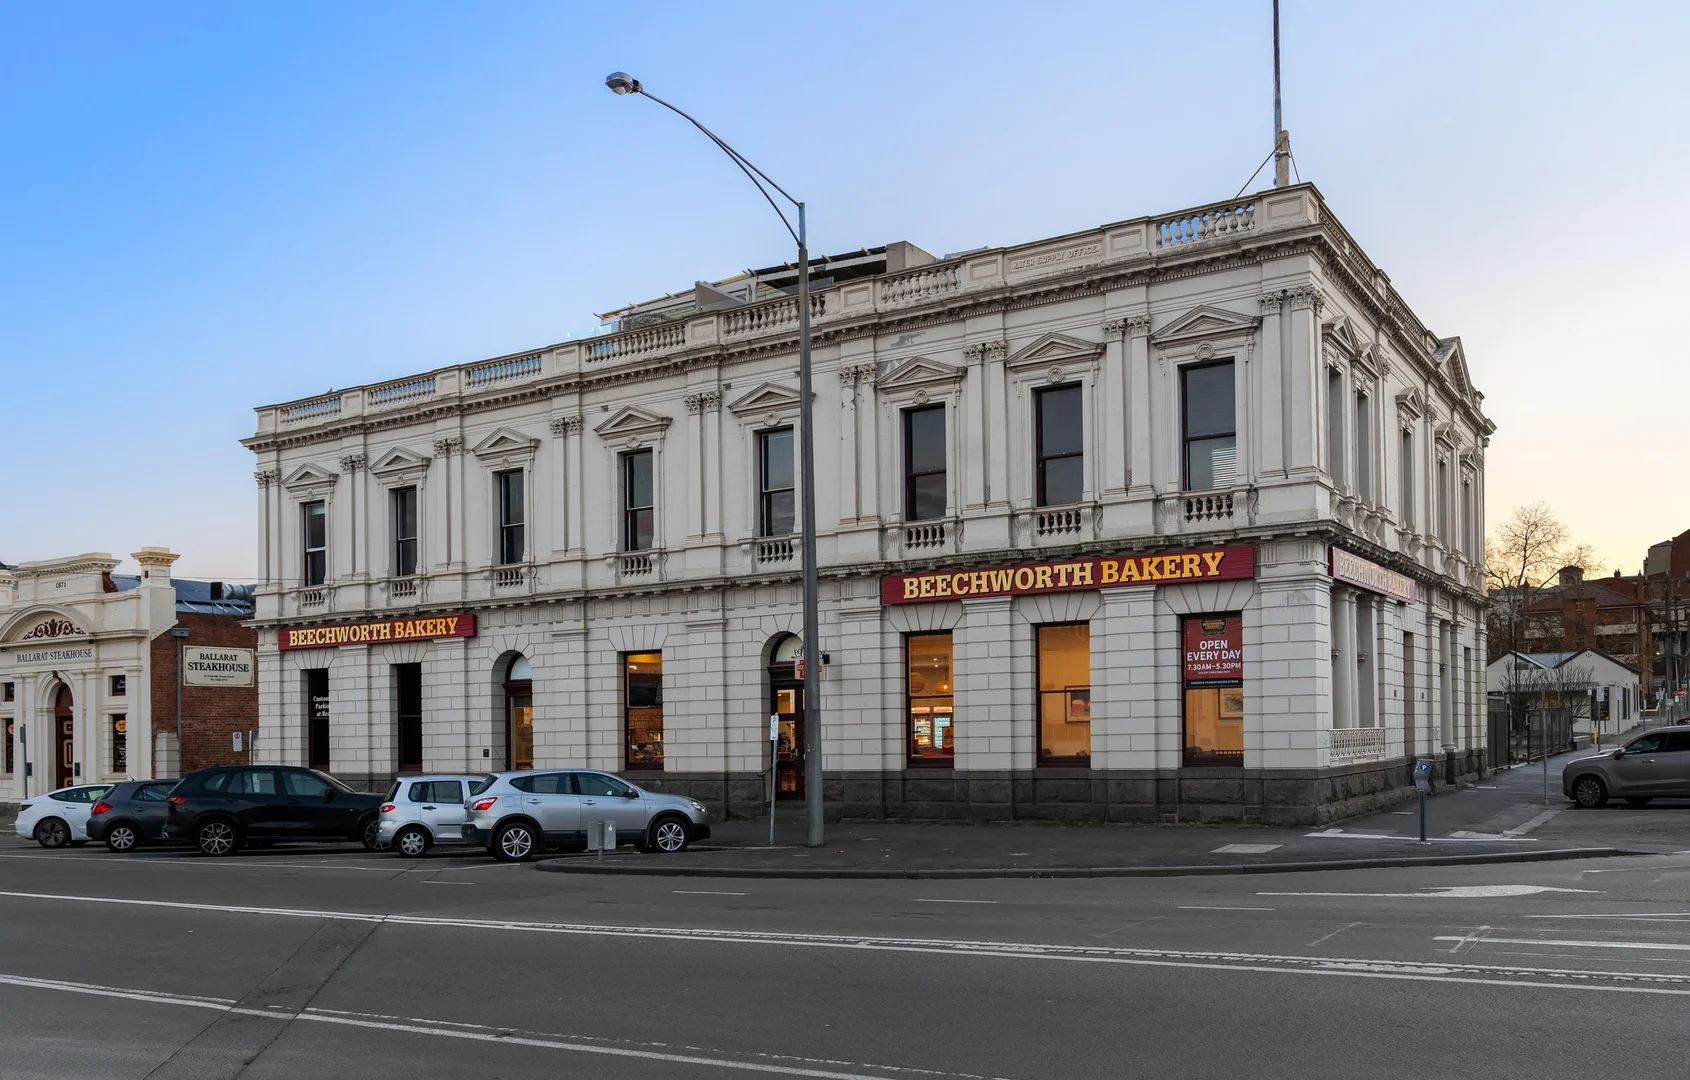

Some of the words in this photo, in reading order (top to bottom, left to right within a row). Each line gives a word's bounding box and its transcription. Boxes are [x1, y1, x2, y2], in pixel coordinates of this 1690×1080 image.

[1012, 258, 1035, 270] WATER
[1036, 252, 1066, 265] SUPPLY
[903, 562, 1094, 600] BEECHWORTH
[1100, 551, 1226, 585] BAKERY
[1339, 552, 1388, 592] BEECHWORTH
[1387, 570, 1412, 601] BAKERY
[289, 623, 391, 647] BEECHWORTH
[395, 617, 459, 639] BAKERY
[1199, 639, 1228, 650] OPEN
[16, 651, 49, 663] BALLARAT
[49, 648, 93, 661] STEAKHOUSE
[199, 652, 238, 661] BALLARAT
[1186, 650, 1220, 661] EVERY
[1221, 649, 1242, 660] DAY
[187, 661, 250, 672] STEAKHOUSE
